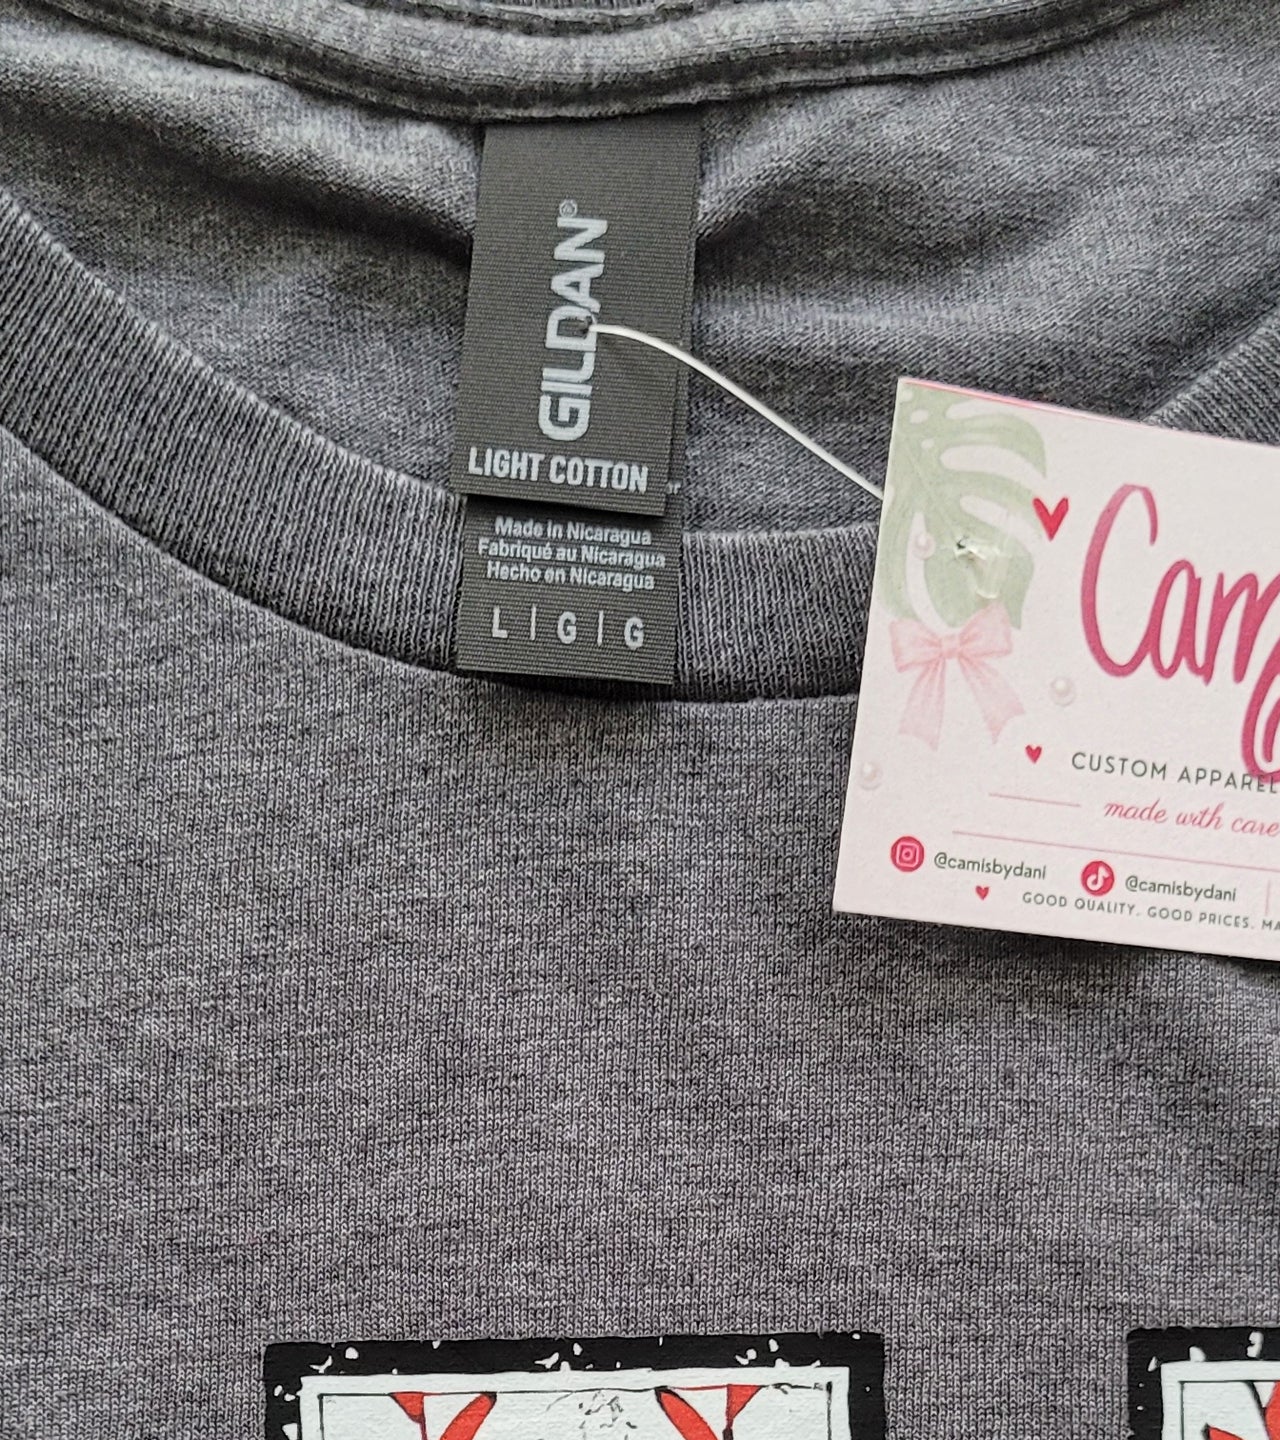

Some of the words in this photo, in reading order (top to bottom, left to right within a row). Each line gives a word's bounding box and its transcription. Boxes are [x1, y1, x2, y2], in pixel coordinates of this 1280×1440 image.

[468, 446, 545, 481] LIGHT
[549, 456, 648, 494] COTTON
[494, 515, 543, 538] Made
[547, 520, 562, 538] in
[567, 521, 652, 547] Nicaragua
[478, 537, 552, 563] Fabriqué
[556, 547, 577, 561] au
[581, 546, 666, 570] Nicaragua
[487, 560, 541, 583] Hecho
[544, 566, 566, 584] en
[570, 567, 655, 592] Nicaragua
[491, 606, 508, 639] L
[558, 611, 578, 644] G
[624, 617, 645, 650] G
[1071, 751, 1168, 782] CUSTOM
[1177, 766, 1278, 794] APPAREL
[1104, 799, 1170, 824] made
[1174, 801, 1225, 831] with
[933, 851, 1047, 882] @camisbydani
[1125, 875, 1237, 904] @camisbydani
[1022, 890, 1068, 909] GOOD
[1073, 898, 1141, 918] QUALITY.
[1147, 905, 1194, 923] GOOD
[1198, 912, 1255, 930] PRICES.
